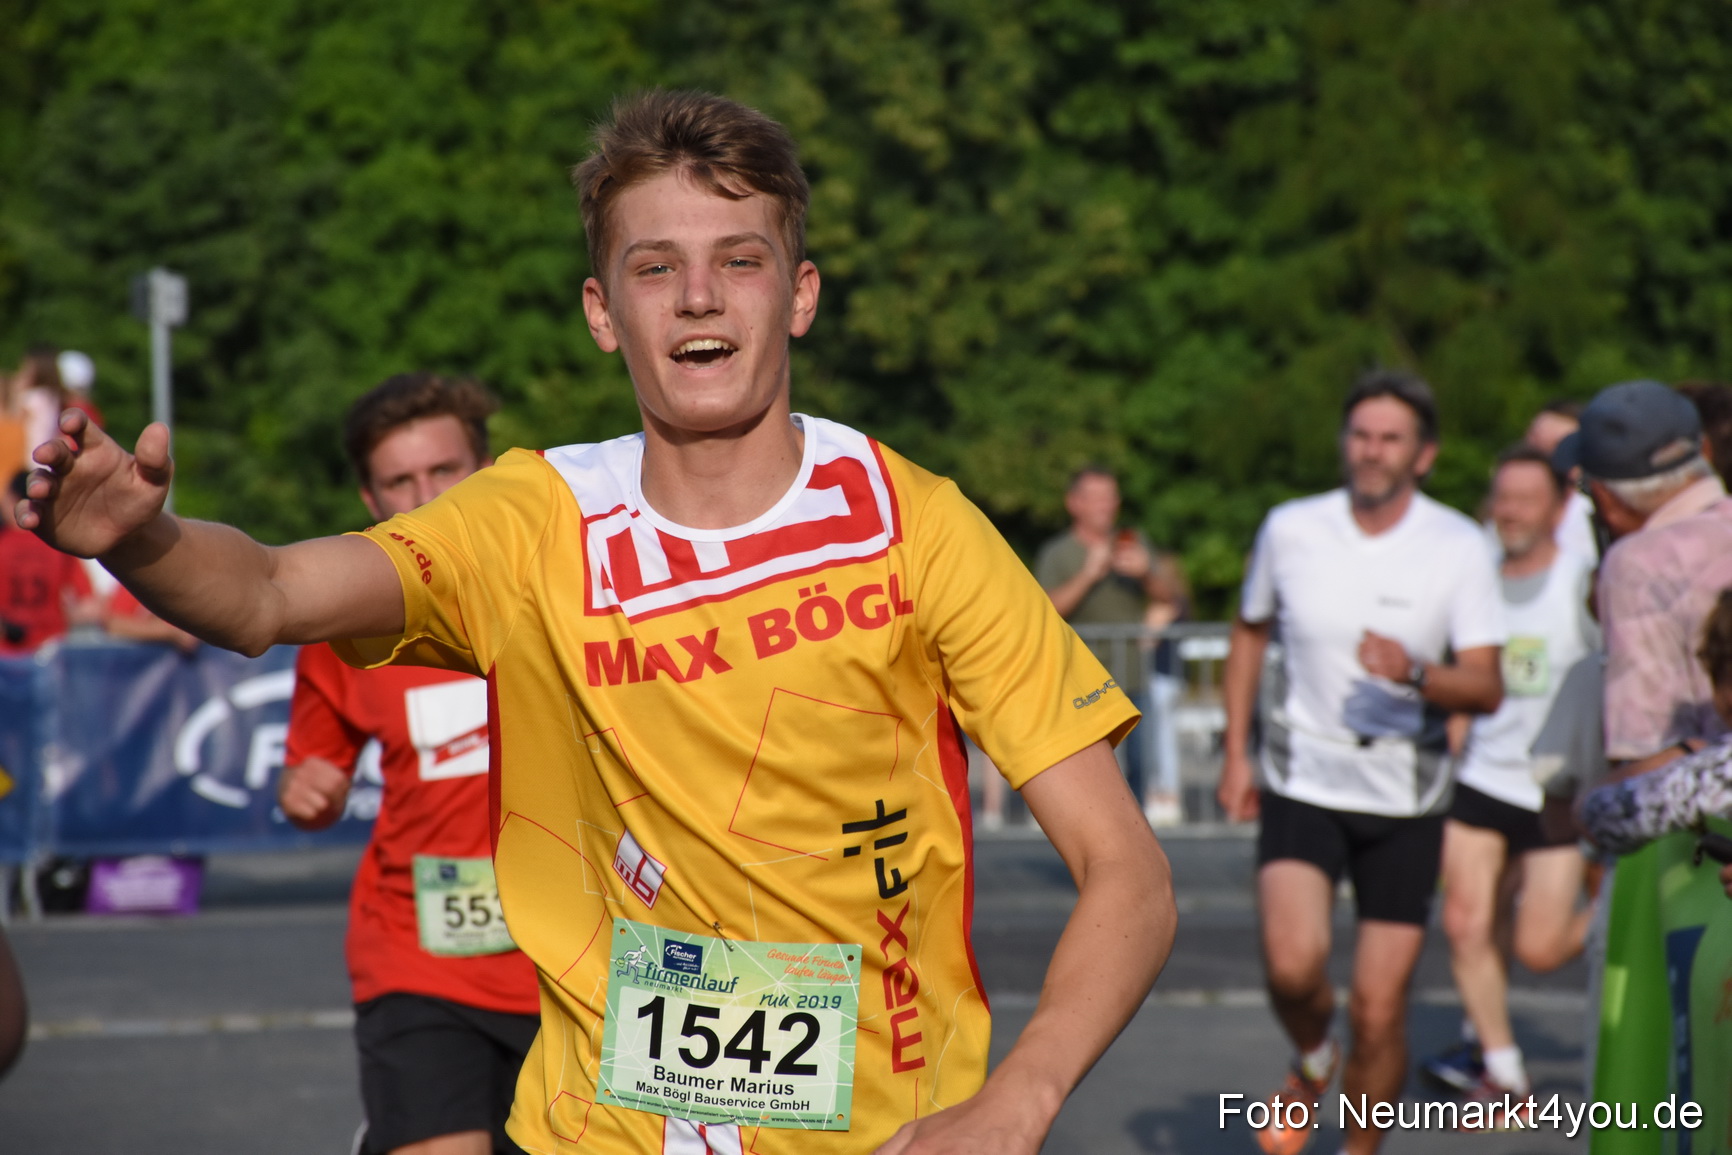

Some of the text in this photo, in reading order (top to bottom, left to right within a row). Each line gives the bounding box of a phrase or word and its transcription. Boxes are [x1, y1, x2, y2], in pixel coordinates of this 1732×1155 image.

[583, 572, 914, 687] MAX BÖGL
[444, 895, 505, 929] 55
[670, 948, 697, 960] Fischer
[767, 948, 845, 969] Gesunde Firmen
[644, 961, 740, 993] firmenlauf
[784, 963, 815, 978] laufen
[644, 980, 683, 993] neumarkt
[759, 993, 842, 1009] run 2019
[637, 995, 821, 1076] 1542
[635, 1080, 810, 1111] Max Bögl Bauservice GmbH
[653, 1065, 795, 1096] Baumer Marius
